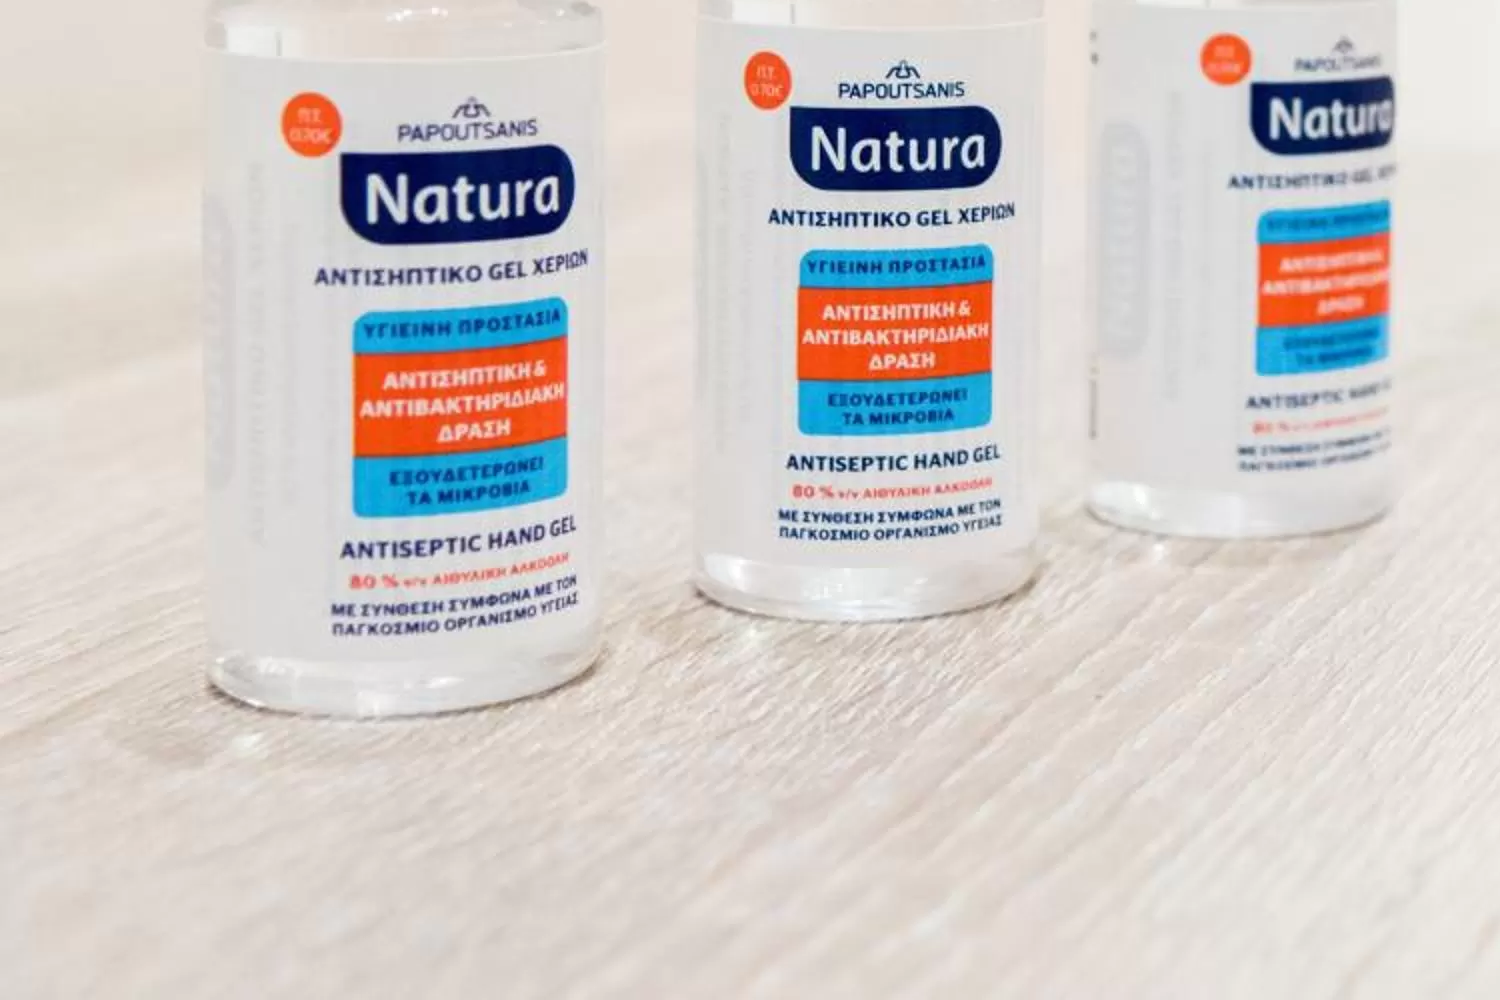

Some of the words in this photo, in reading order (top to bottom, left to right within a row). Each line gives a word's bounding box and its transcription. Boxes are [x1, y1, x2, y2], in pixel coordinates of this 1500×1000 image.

[838, 82, 965, 99] PAPOUTSANIS
[397, 120, 538, 143] PAPOUTSANIS
[811, 125, 985, 172] Natura
[366, 173, 559, 224] Natura
[768, 208, 911, 228] ΑΝΤΙΣΗΠΤΙΚΟ
[916, 210, 952, 227] GEL
[957, 202, 1016, 225] ΧΕΡΙΩΝ
[315, 263, 482, 286] ΑΝΤΙΣΗΠΤΙΚΟ
[489, 260, 527, 280] GEL
[532, 248, 588, 276] ΧΕΡΙΩΝ
[807, 259, 883, 275] ΥΓΙΕΙΝΗ
[888, 255, 986, 274] ΠΡΟΣΤΑΣΙΑ
[363, 318, 451, 339] ΥΓΙΕΙΝΗ
[458, 308, 561, 335] ΠΡΟΣΤΑΣΙΑ
[822, 302, 957, 321] ΑΝΤΙΣΗΠΤΙΚΗ
[802, 322, 989, 345] ΑΝΤΙΒΑΚΤΗΡΙΔΙΑΚΗ
[868, 352, 936, 371] ΔΡΑΣΗ
[382, 362, 531, 390] ΑΝΤΙΣΗΠΤΙΚΗ
[359, 382, 564, 418] ΑΝΤΙΒΑΚΤΗΡΙΔΙΑΚΗ
[842, 412, 864, 425] ΤΑ
[869, 408, 955, 426] ΜΙΚΡΟΒΙΑ
[436, 418, 511, 443] ΔΡΑΣΗ
[786, 454, 909, 473] ANTISEPTIC
[914, 449, 969, 470] HAND
[973, 444, 1001, 463] GEL
[406, 488, 432, 505] ΤΑ
[437, 480, 530, 504] ΜΙΚΡΟΒΙΑ
[792, 484, 815, 498] 80
[778, 508, 799, 522] ΜΕ
[802, 510, 874, 524] ΣΥΝΘΕΣΗ
[877, 507, 954, 523] ΣΥΜΦΩΝΑ
[957, 501, 976, 516] ΜΕ
[340, 535, 481, 560] ANTISEPTIC
[488, 524, 545, 550] HAND
[549, 515, 576, 537] GEL
[779, 525, 870, 542] ΠΑΓΚΟΣΜΙΟ
[873, 523, 960, 540] ΟΡΓΑΝΙΣΜΟ
[349, 574, 376, 589] 80
[331, 603, 356, 616] ΜΕ
[361, 599, 444, 617] ΣΥΝΘΕΣΗ
[448, 590, 531, 612] ΣΥΜΦΩΝΑ
[534, 582, 553, 598] ΜΕ
[332, 621, 440, 637] ΠΑΓΚΟΣΜΙΟ
[443, 606, 537, 632] ΟΡΓΑΝΙΣΜΟ
